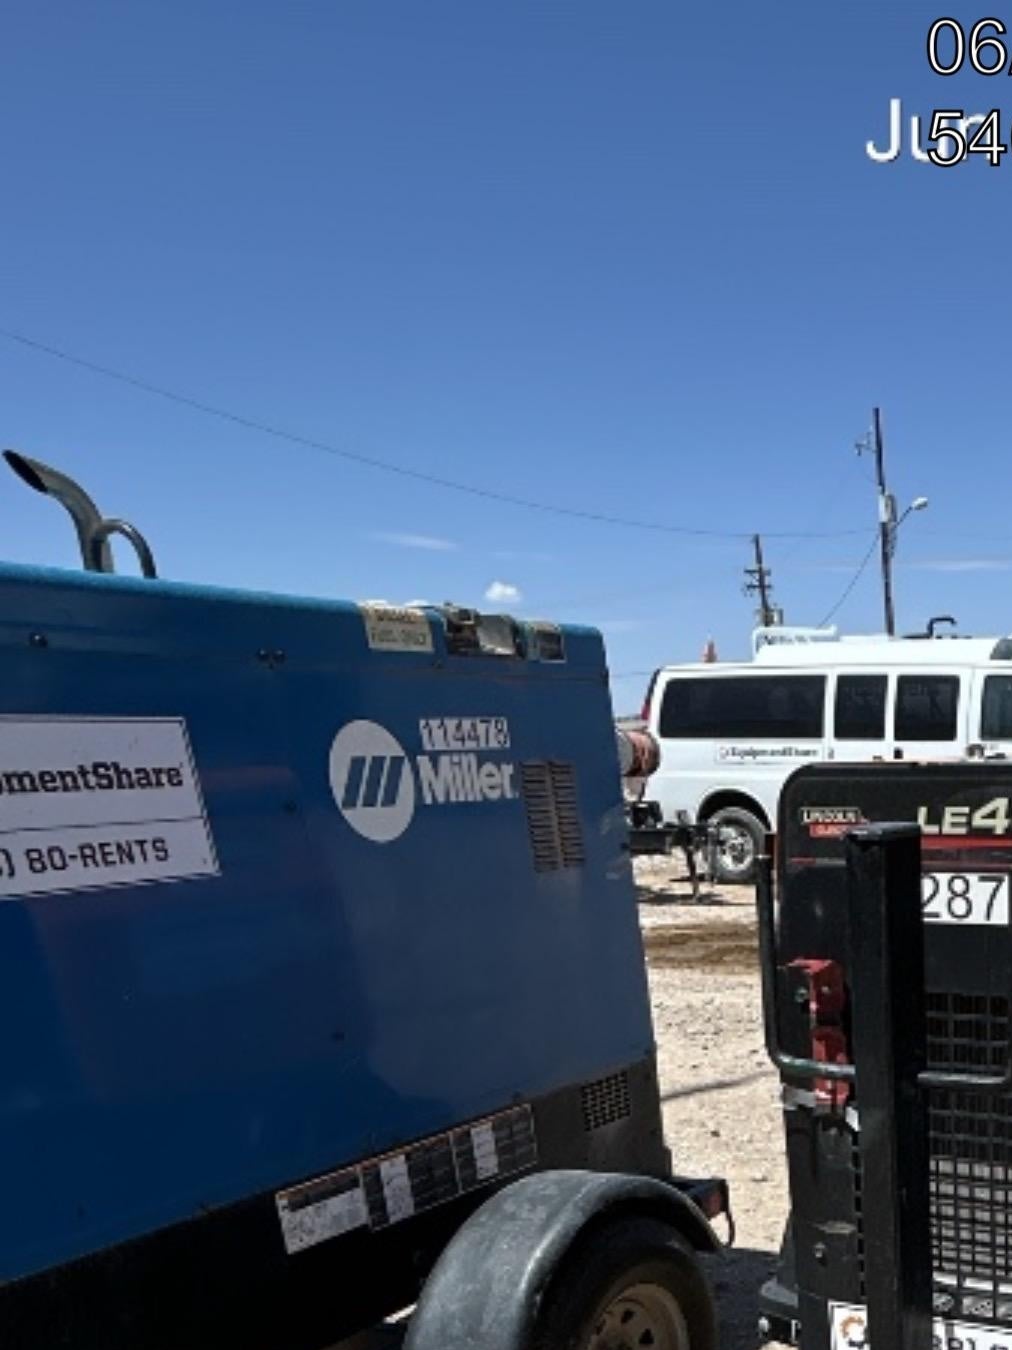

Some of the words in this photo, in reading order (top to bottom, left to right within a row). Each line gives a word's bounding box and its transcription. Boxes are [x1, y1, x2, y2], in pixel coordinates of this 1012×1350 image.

[0, 762, 184, 796] mentShare
[416, 752, 515, 804] Miller
[25, 838, 170, 875] 80-RENTS
